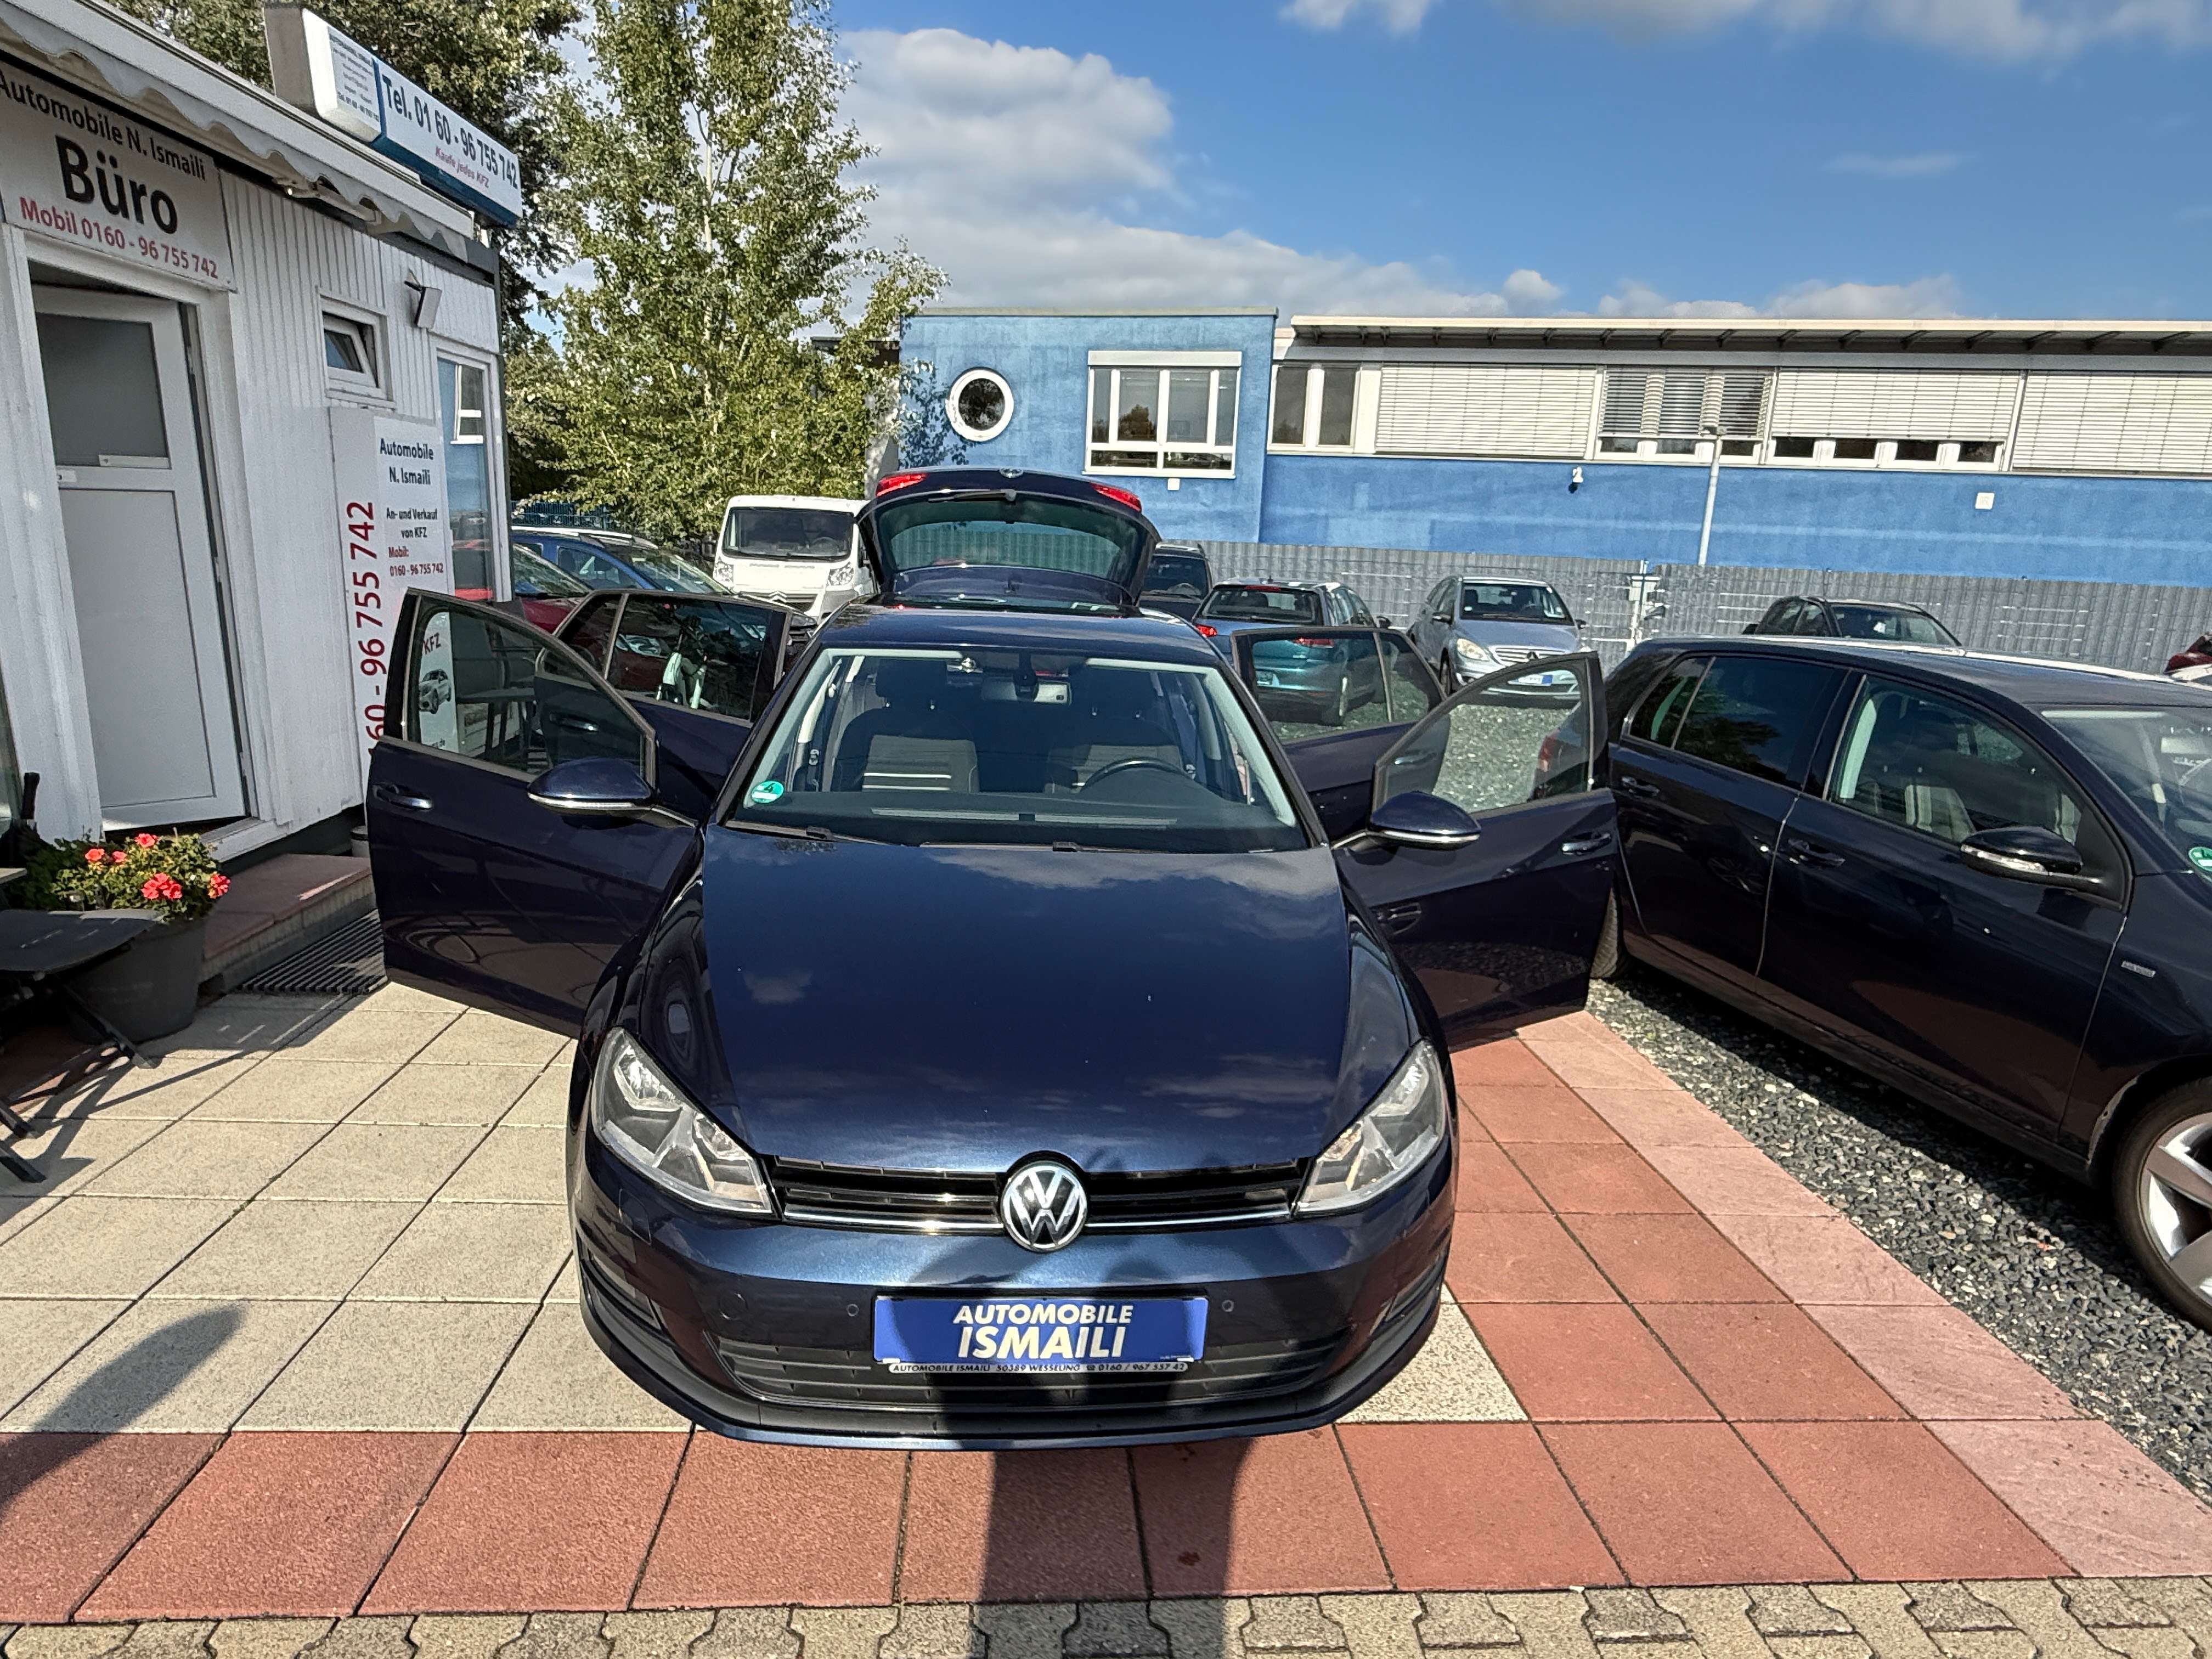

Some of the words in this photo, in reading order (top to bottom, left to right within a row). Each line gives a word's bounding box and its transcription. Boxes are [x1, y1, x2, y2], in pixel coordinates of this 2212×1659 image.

[0, 69, 123, 146] Automobile
[126, 126, 147, 156] N.
[150, 137, 206, 181] Ismaili
[382, 74, 411, 121] Tel.
[414, 95, 431, 133] 01
[435, 110, 451, 145] 60
[460, 127, 476, 161] 96
[477, 138, 498, 176] 755
[499, 154, 518, 189] 742
[55, 135, 178, 235] Büro
[476, 171, 489, 188] KFZ
[20, 196, 78, 235] Mobil
[82, 218, 125, 249] 0160
[138, 236, 159, 260] 96
[161, 243, 189, 269] 755
[191, 253, 218, 279] 742
[380, 438, 434, 460] Automobile
[390, 466, 399, 483] N.
[401, 468, 431, 485] Ismaili
[387, 507, 398, 520] An-
[399, 511, 411, 520] und
[412, 509, 437, 520] Verkauf
[347, 502, 377, 560] 742
[401, 529, 414, 539] von
[415, 527, 427, 538] KFZ
[390, 565, 406, 577] 0160
[410, 564, 419, 575] 96
[419, 563, 431, 574] 755
[432, 562, 443, 573] 742
[352, 572, 383, 628] 755
[358, 639, 387, 676] 96
[423, 632, 441, 654] KFZ
[1005, 1164, 1085, 1248] VW
[953, 1304, 1133, 1324] AUTOMOBILE
[958, 1326, 1126, 1359] ISMAILI
